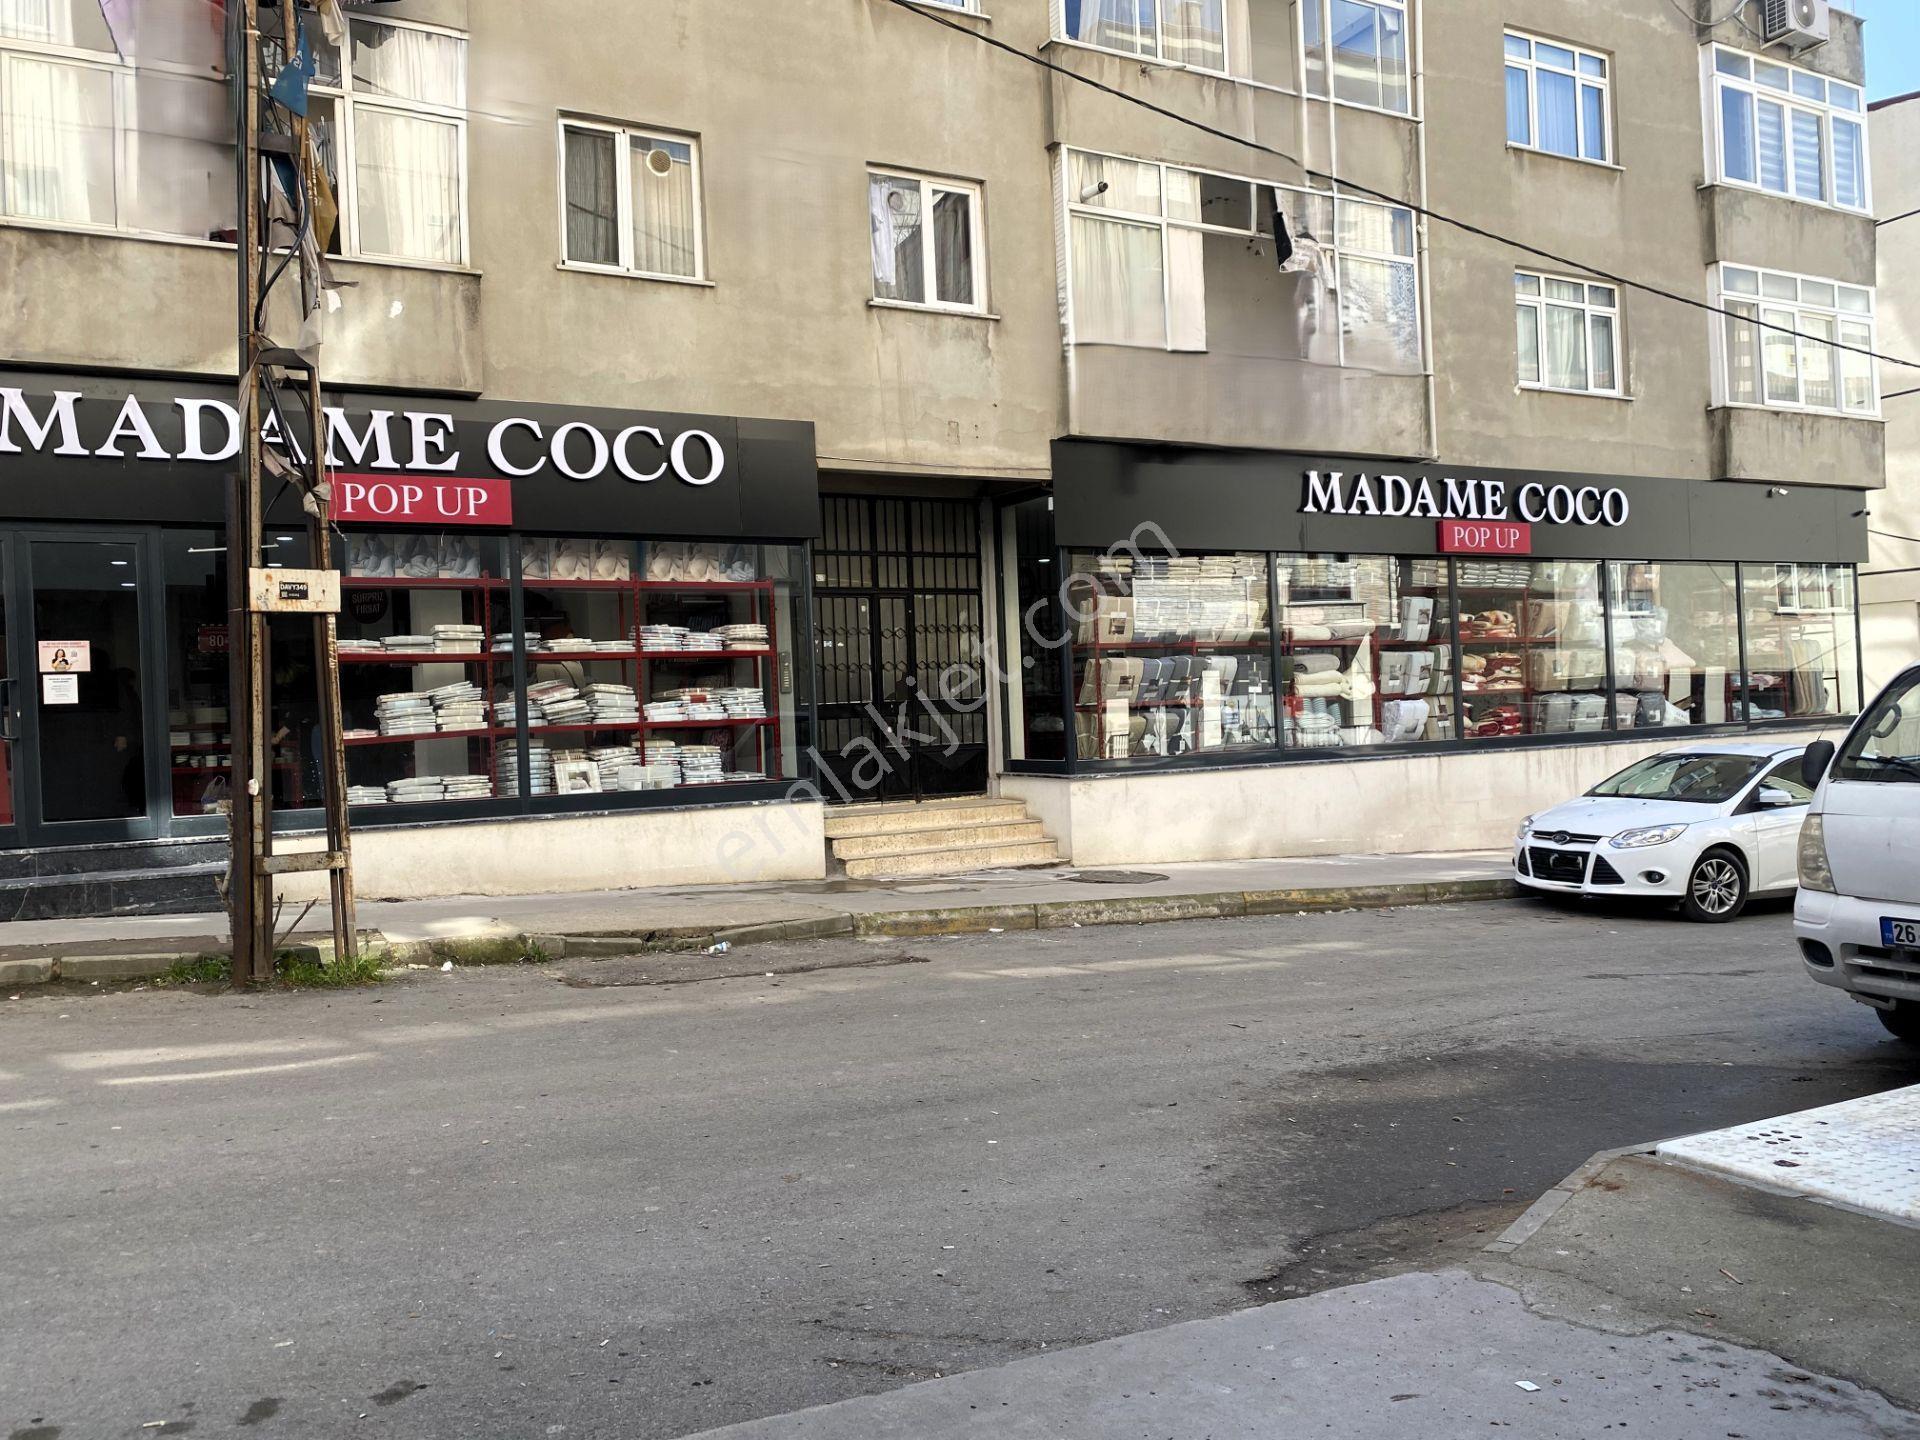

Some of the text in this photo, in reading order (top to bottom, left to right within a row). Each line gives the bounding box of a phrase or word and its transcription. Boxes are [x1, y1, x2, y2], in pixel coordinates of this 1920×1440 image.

[0, 387, 725, 485] MADAME COCO
[341, 482, 489, 517] POP UP
[1303, 470, 1630, 527] MADAME COCO
[1453, 526, 1520, 550] POP UP
[1893, 923, 1917, 944] 26
